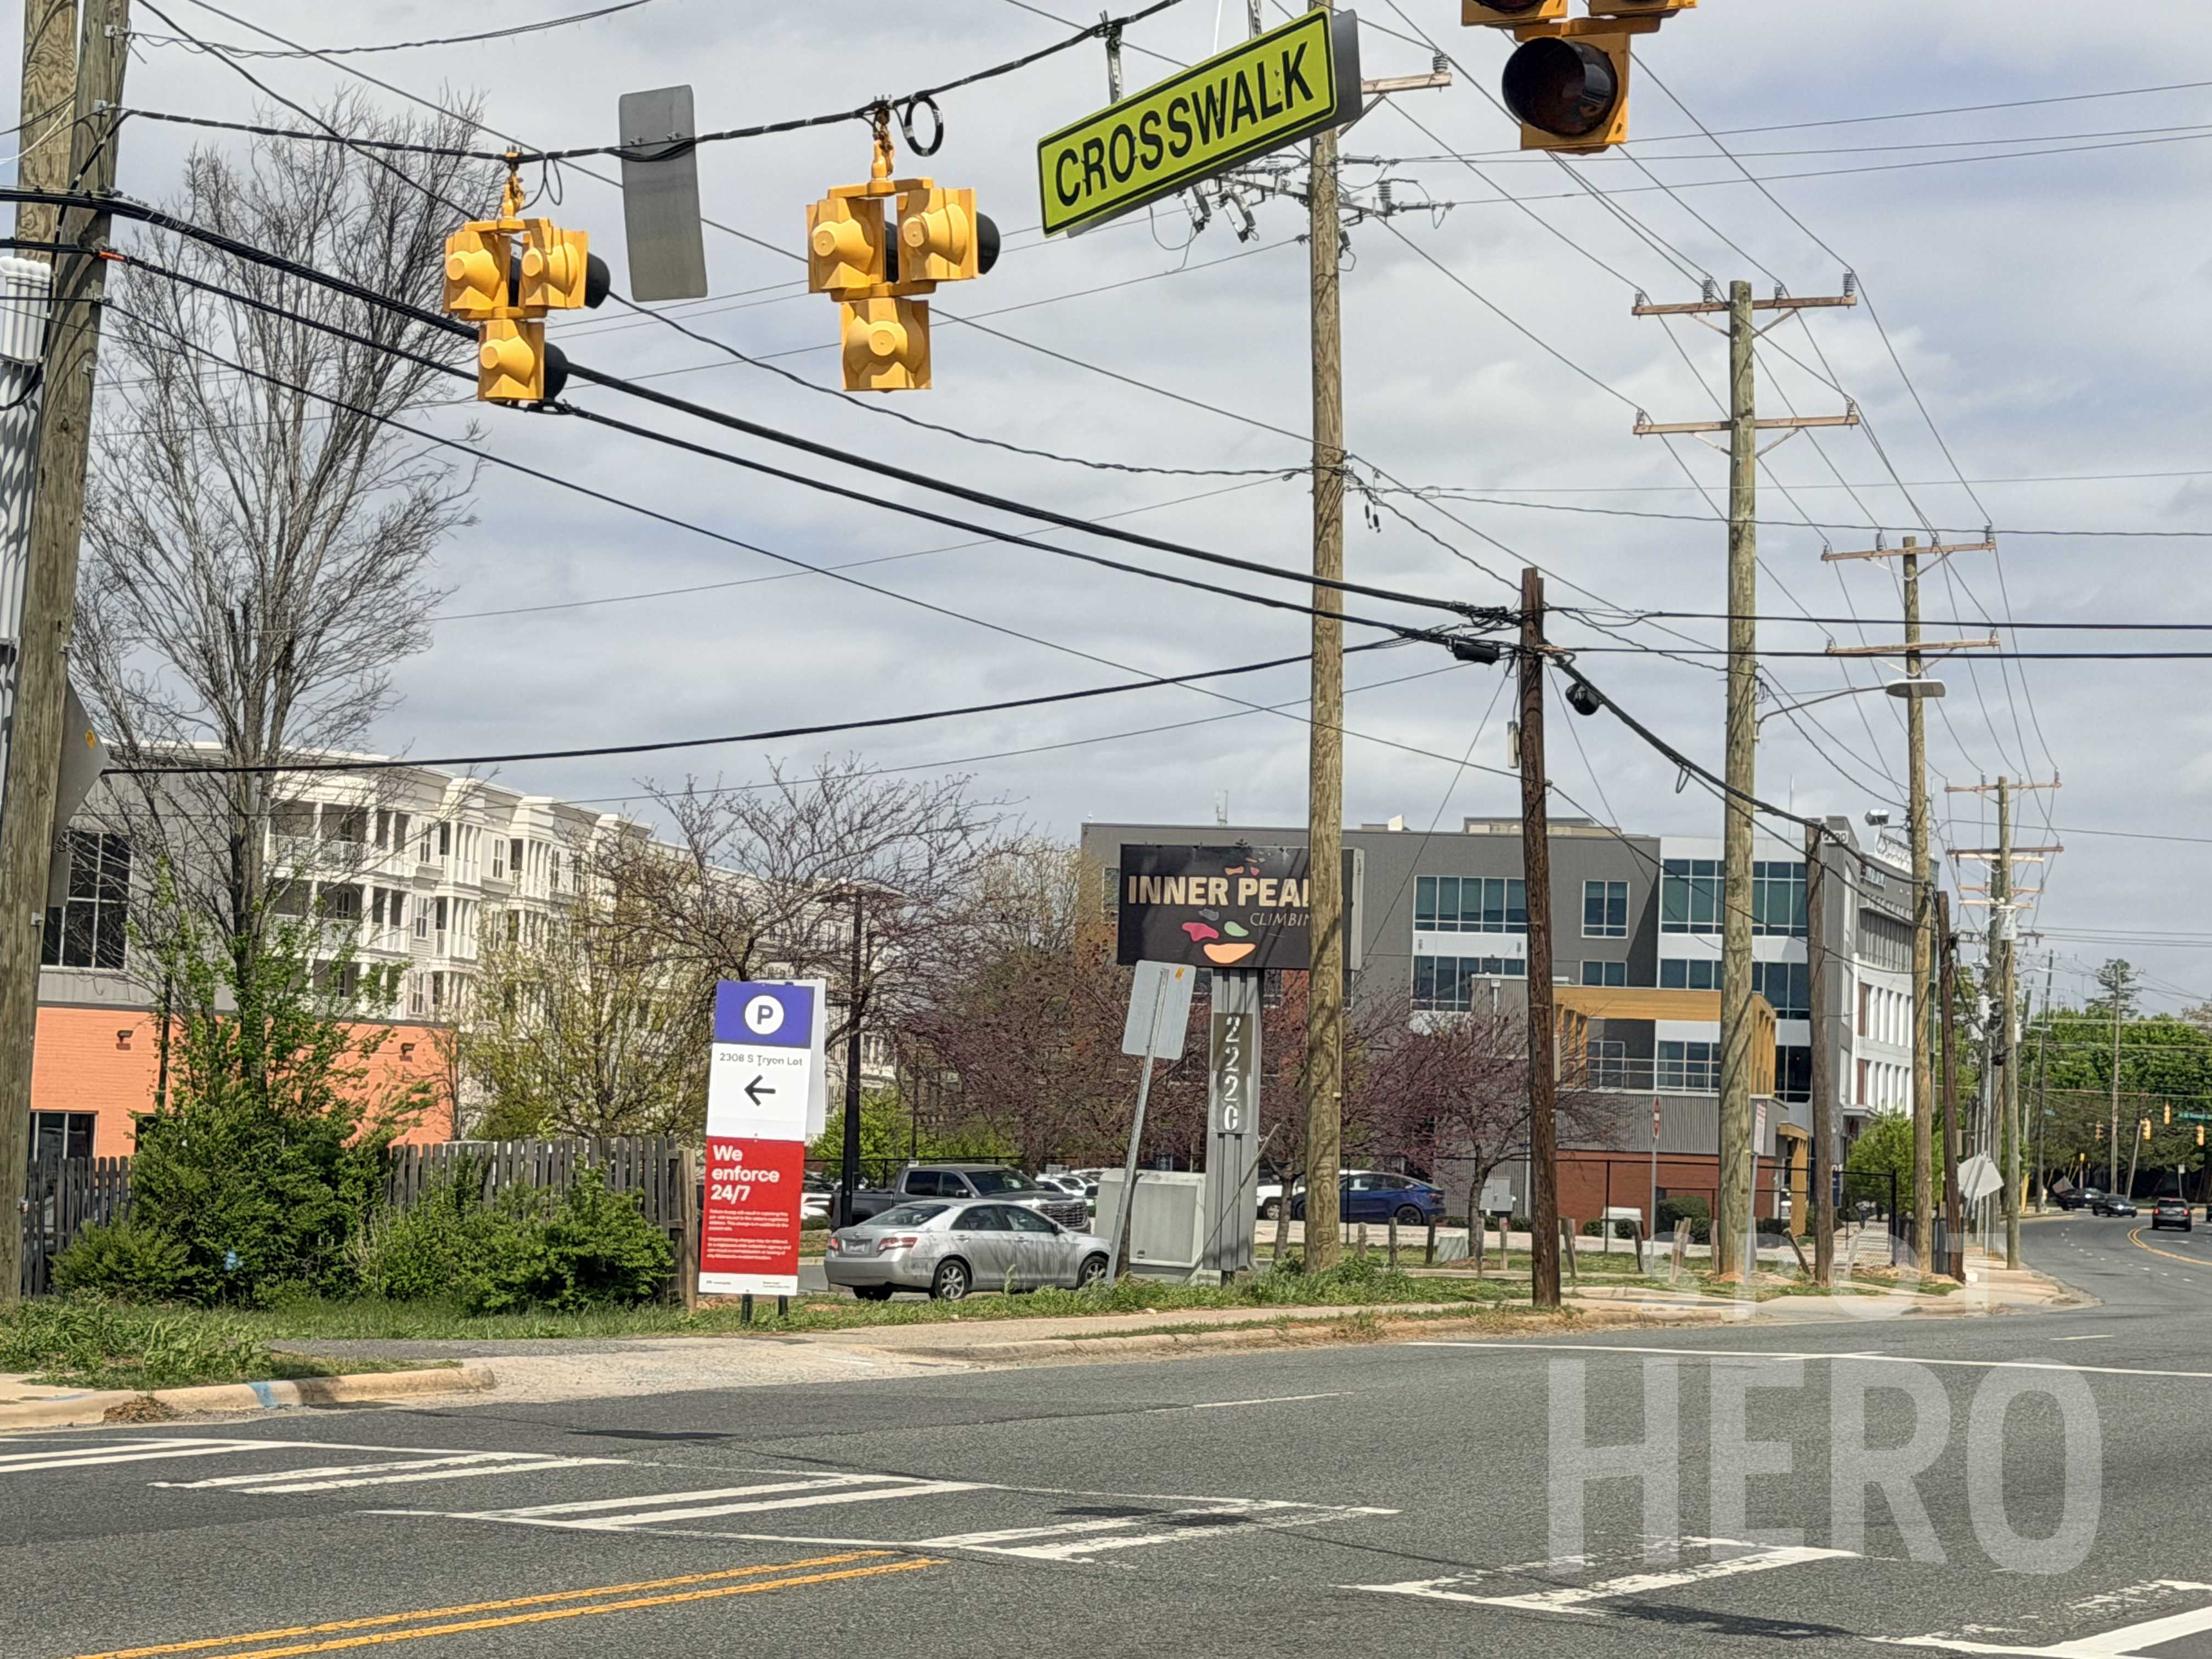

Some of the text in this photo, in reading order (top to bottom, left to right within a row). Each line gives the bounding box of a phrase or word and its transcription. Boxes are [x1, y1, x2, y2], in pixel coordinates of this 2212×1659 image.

[1056, 41, 1314, 206] CROSSWALK
[1128, 876, 1310, 907] INNER PEA
[757, 1005, 774, 1025] P
[719, 1052, 803, 1066] 2308 S Tryon Lot
[713, 1144, 743, 1161] We
[712, 1165, 780, 1183] enforce
[710, 1184, 751, 1205] 24/7
